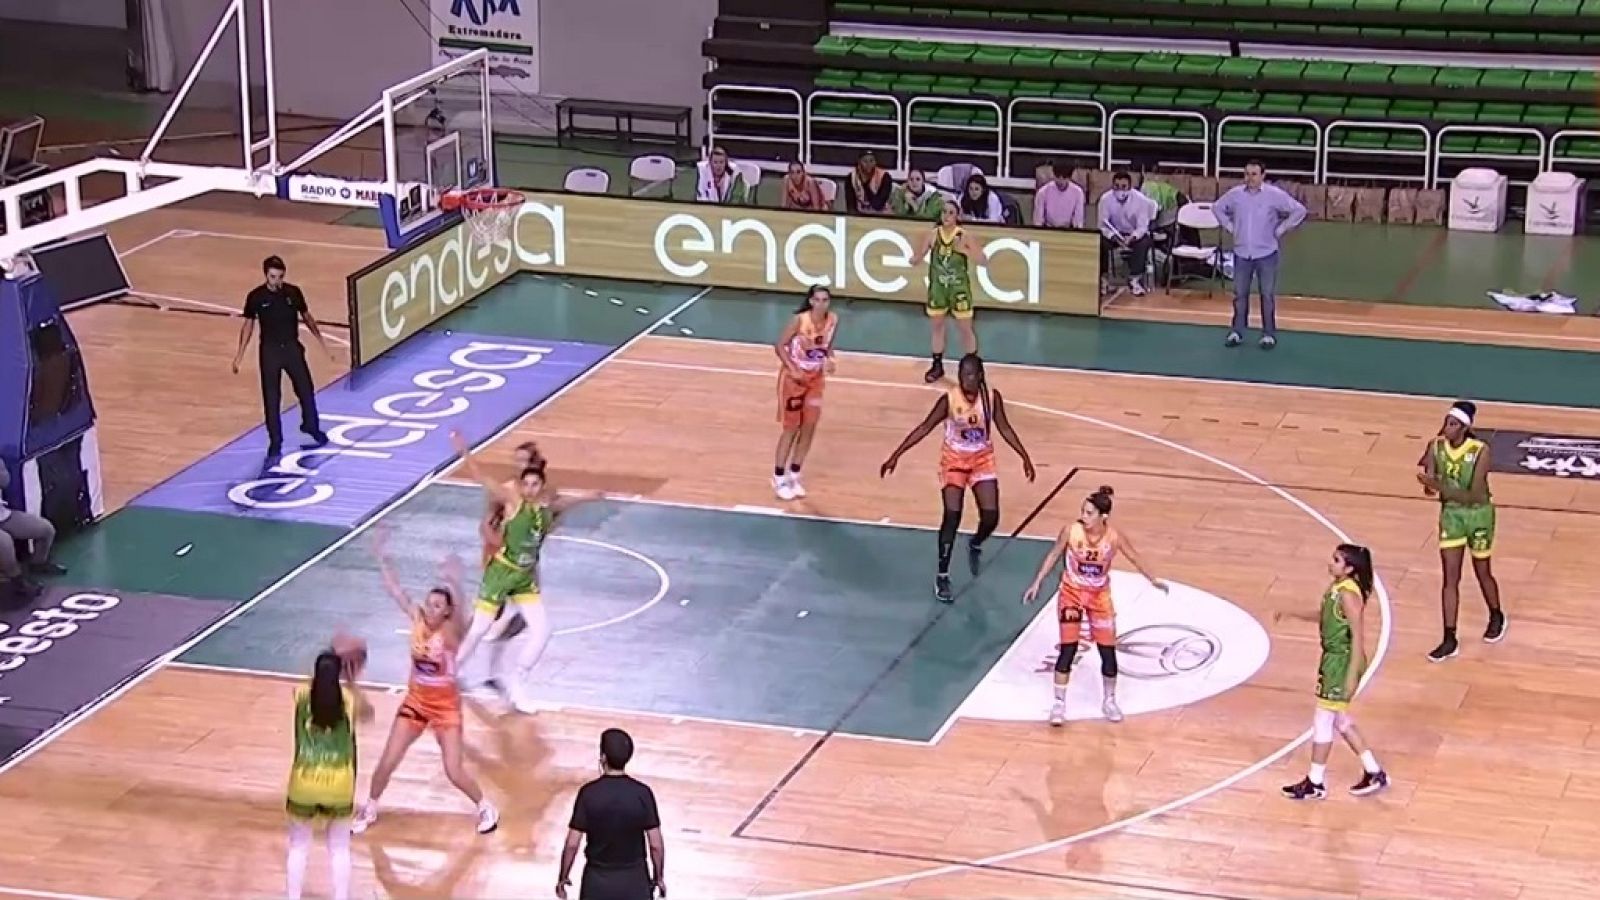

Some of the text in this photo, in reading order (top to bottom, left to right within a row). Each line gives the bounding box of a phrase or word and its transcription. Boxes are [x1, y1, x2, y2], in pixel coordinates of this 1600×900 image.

[448, 25, 522, 40] Extremadura
[301, 184, 336, 197] RADIO
[380, 202, 565, 339] endesa
[654, 213, 1040, 304] endea
[227, 341, 553, 509] endesa
